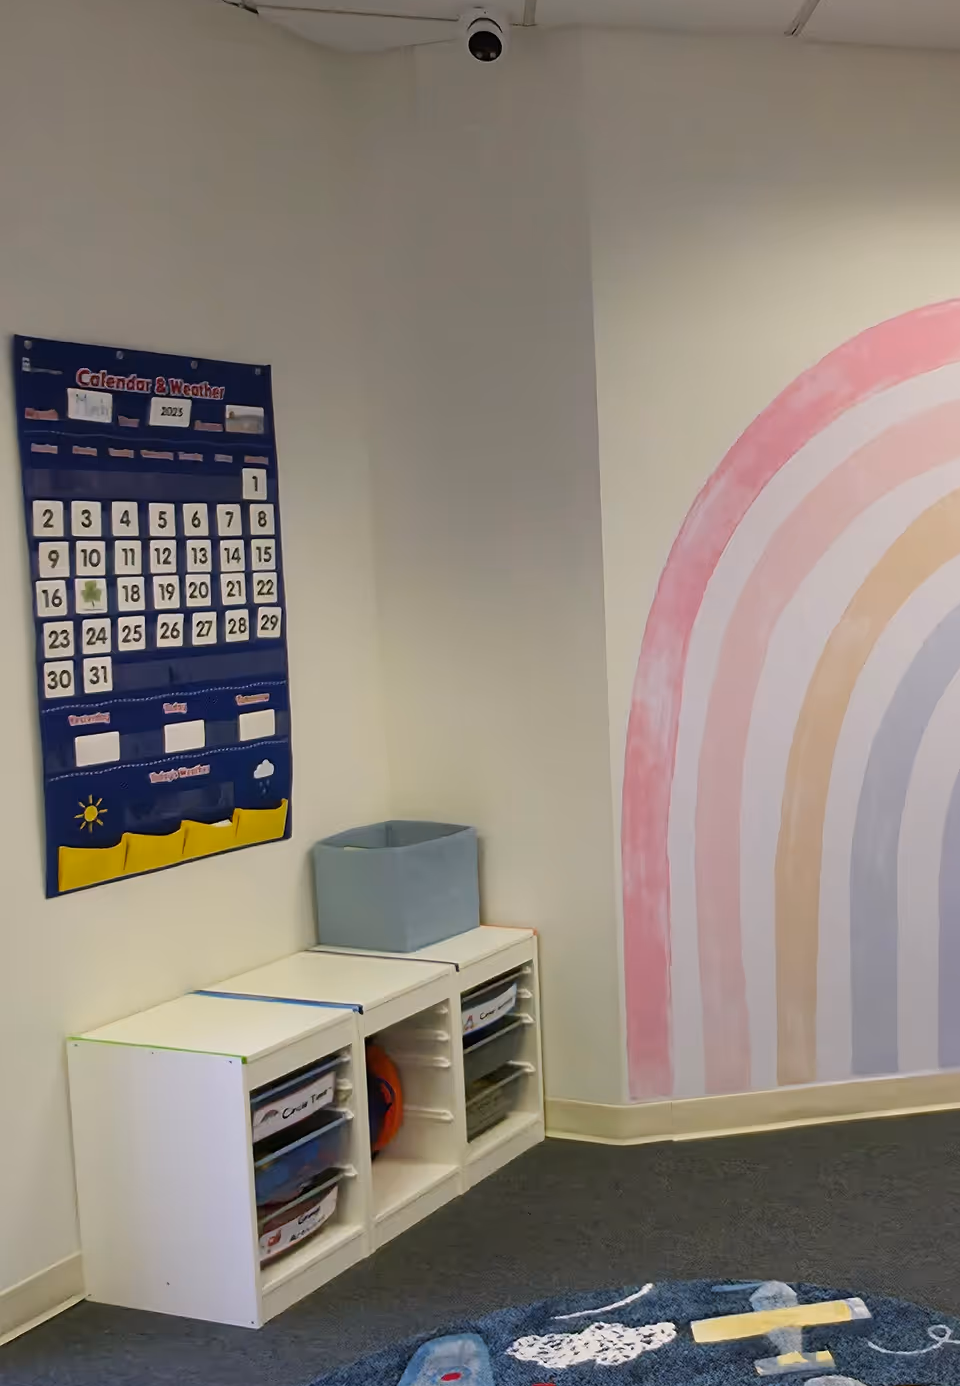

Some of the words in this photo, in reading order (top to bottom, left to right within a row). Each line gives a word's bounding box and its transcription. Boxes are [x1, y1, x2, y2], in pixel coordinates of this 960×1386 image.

[76, 368, 152, 393] Calendar
[155, 377, 168, 395] &
[168, 378, 225, 400] Weather
[251, 475, 259, 492] 1
[42, 508, 54, 529] 2
[80, 509, 92, 528] 3
[119, 510, 131, 527] 4
[157, 511, 167, 529] 5
[191, 510, 201, 528] 6
[225, 511, 234, 528] 7
[257, 510, 267, 528] 8
[47, 549, 60, 569] 9
[80, 548, 101, 568] 10
[121, 548, 136, 566] 11
[154, 547, 172, 565] 12
[191, 547, 208, 565] 13
[223, 547, 241, 564] 14
[255, 546, 272, 563] 15
[41, 588, 63, 608] 16
[121, 584, 141, 603] 18
[158, 582, 175, 601] 19
[188, 581, 209, 599] 20
[226, 580, 242, 597] 21
[256, 579, 274, 596] 22
[48, 629, 71, 650] 23
[86, 627, 108, 646] 24
[121, 624, 143, 644] 25
[159, 622, 180, 640] 26
[195, 620, 213, 638] 27
[228, 617, 247, 635] 28
[260, 614, 279, 631] 29
[47, 669, 72, 690] 30
[89, 665, 108, 685] 31
